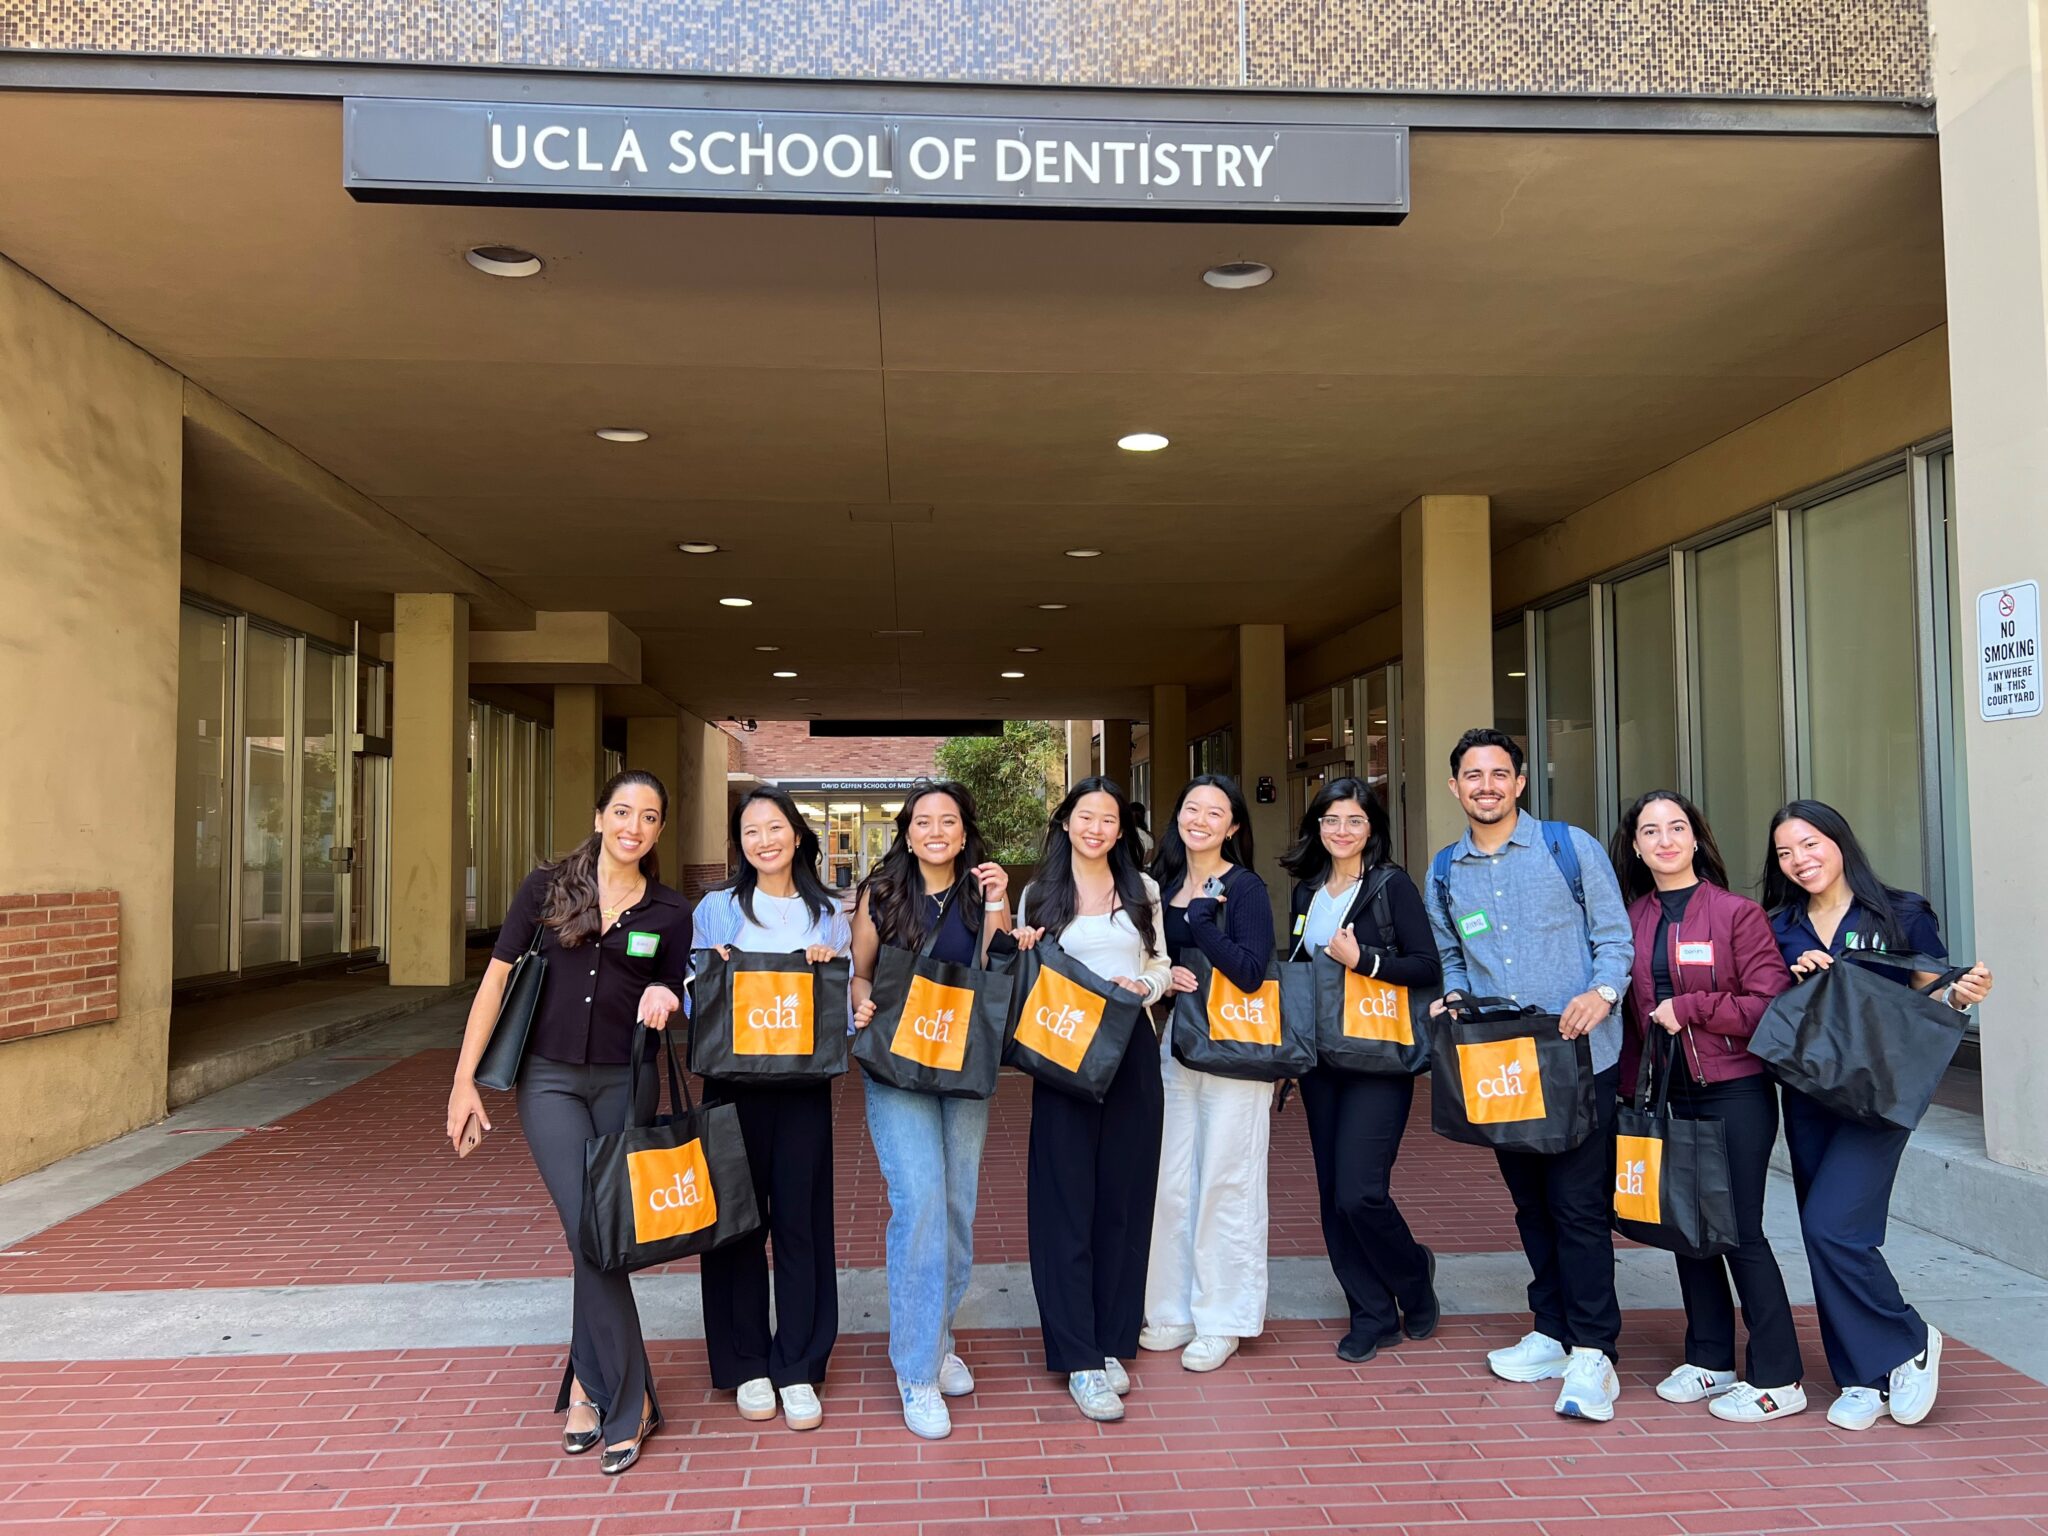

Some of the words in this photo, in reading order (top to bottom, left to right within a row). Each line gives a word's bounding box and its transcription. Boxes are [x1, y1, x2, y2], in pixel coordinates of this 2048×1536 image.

[491, 124, 649, 173] UCLA
[667, 130, 893, 179] SCHOOL
[908, 136, 977, 181] OF
[995, 138, 1275, 188] DENTISTRY
[2001, 620, 2015, 638] NO
[1984, 639, 2035, 663] SMOKING
[1987, 665, 2033, 682] ANYWHERE
[1994, 682, 2002, 693] IN
[2007, 679, 2026, 692] THIS
[1987, 691, 2035, 706] COURTYARD
[748, 994, 800, 1031] cda
[1220, 997, 1266, 1026] cda
[1359, 989, 1398, 1019] cda
[914, 1009, 951, 1044] cda
[1035, 1004, 1078, 1043] cda
[1476, 1063, 1525, 1100] cda
[649, 1171, 701, 1212] cda
[1615, 1160, 1643, 1195] da
